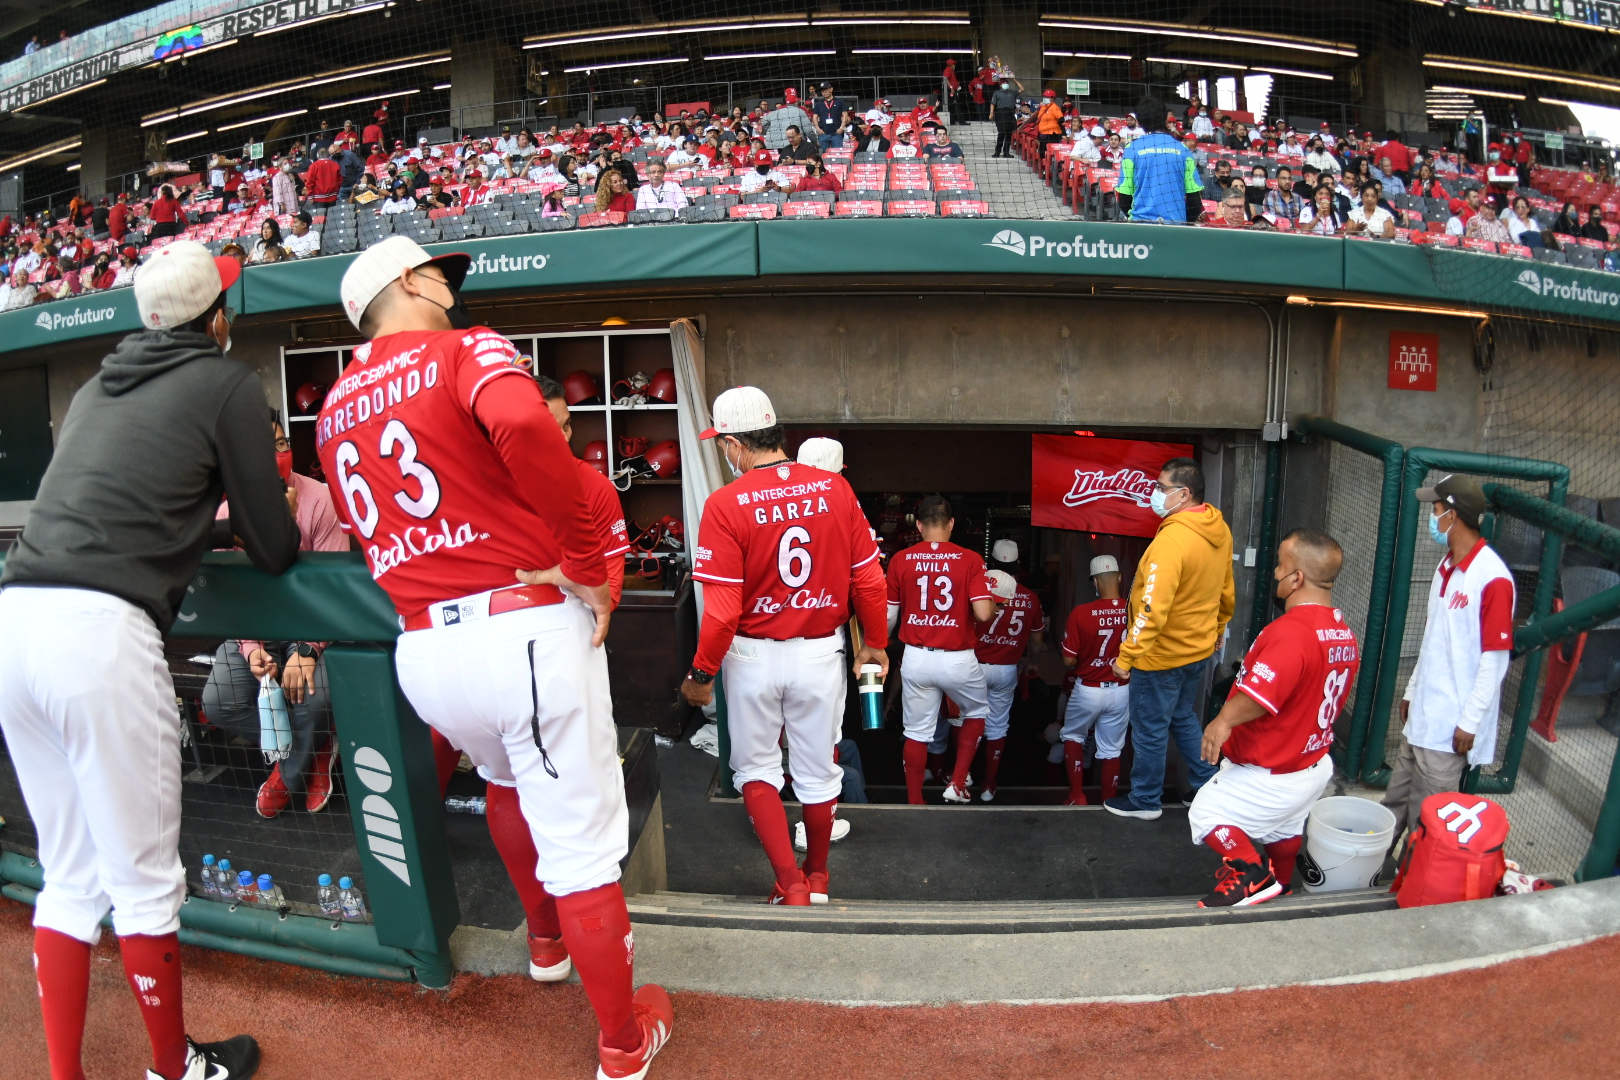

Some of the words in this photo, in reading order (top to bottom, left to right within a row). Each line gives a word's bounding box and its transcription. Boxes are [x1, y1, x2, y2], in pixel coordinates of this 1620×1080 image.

[1029, 235, 1149, 260] Profuturo
[1542, 277, 1620, 306] Profuturo
[53, 307, 115, 330] Profuturo
[332, 348, 421, 404] INTERCERAMIC
[318, 361, 438, 448] ARREDONDO
[335, 418, 442, 541] 63
[751, 480, 832, 502] INTERCERAMIC
[754, 496, 829, 525] GARZA
[777, 525, 813, 589] 6
[912, 552, 961, 560] INTERCERAMIC
[915, 561, 950, 573] AVILA
[916, 574, 954, 612] 13
[1004, 599, 1032, 609] EGAS
[988, 609, 1026, 637] 75
